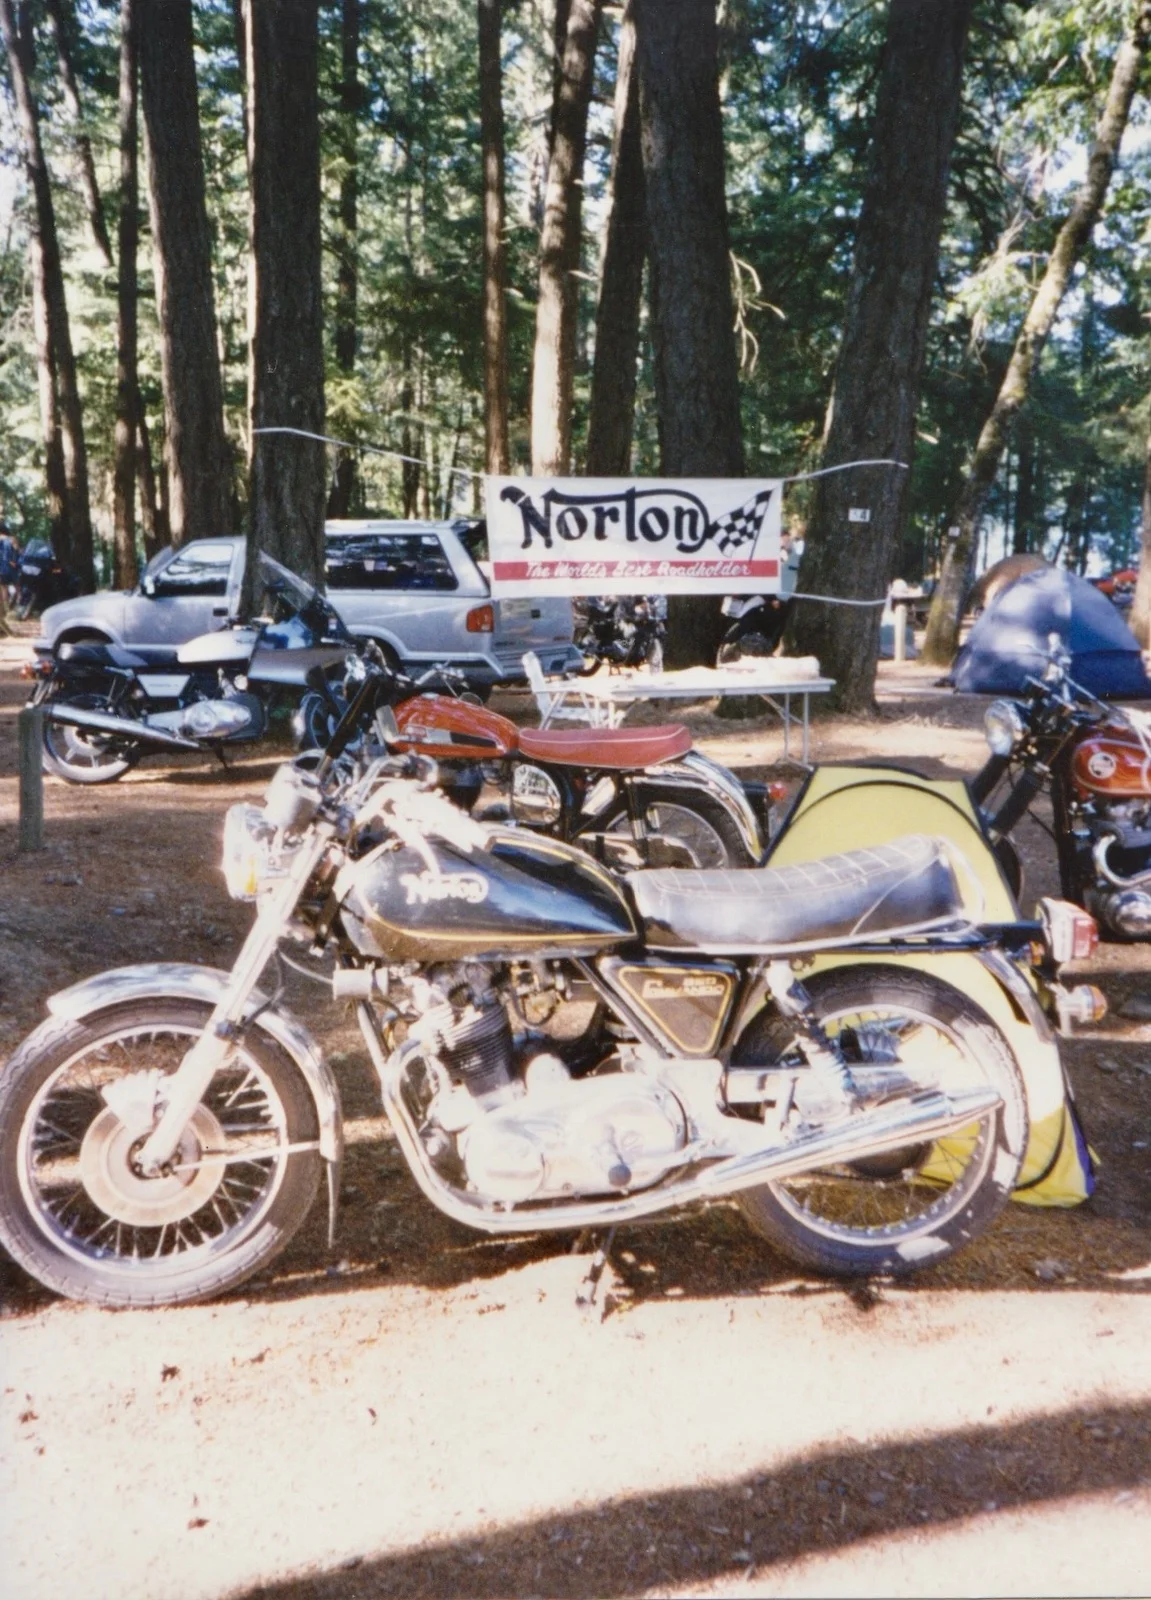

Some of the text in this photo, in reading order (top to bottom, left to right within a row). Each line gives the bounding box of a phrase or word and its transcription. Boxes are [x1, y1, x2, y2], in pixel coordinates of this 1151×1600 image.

[499, 486, 709, 553] Norton
[525, 560, 550, 578] The
[657, 559, 751, 577] Roadholder
